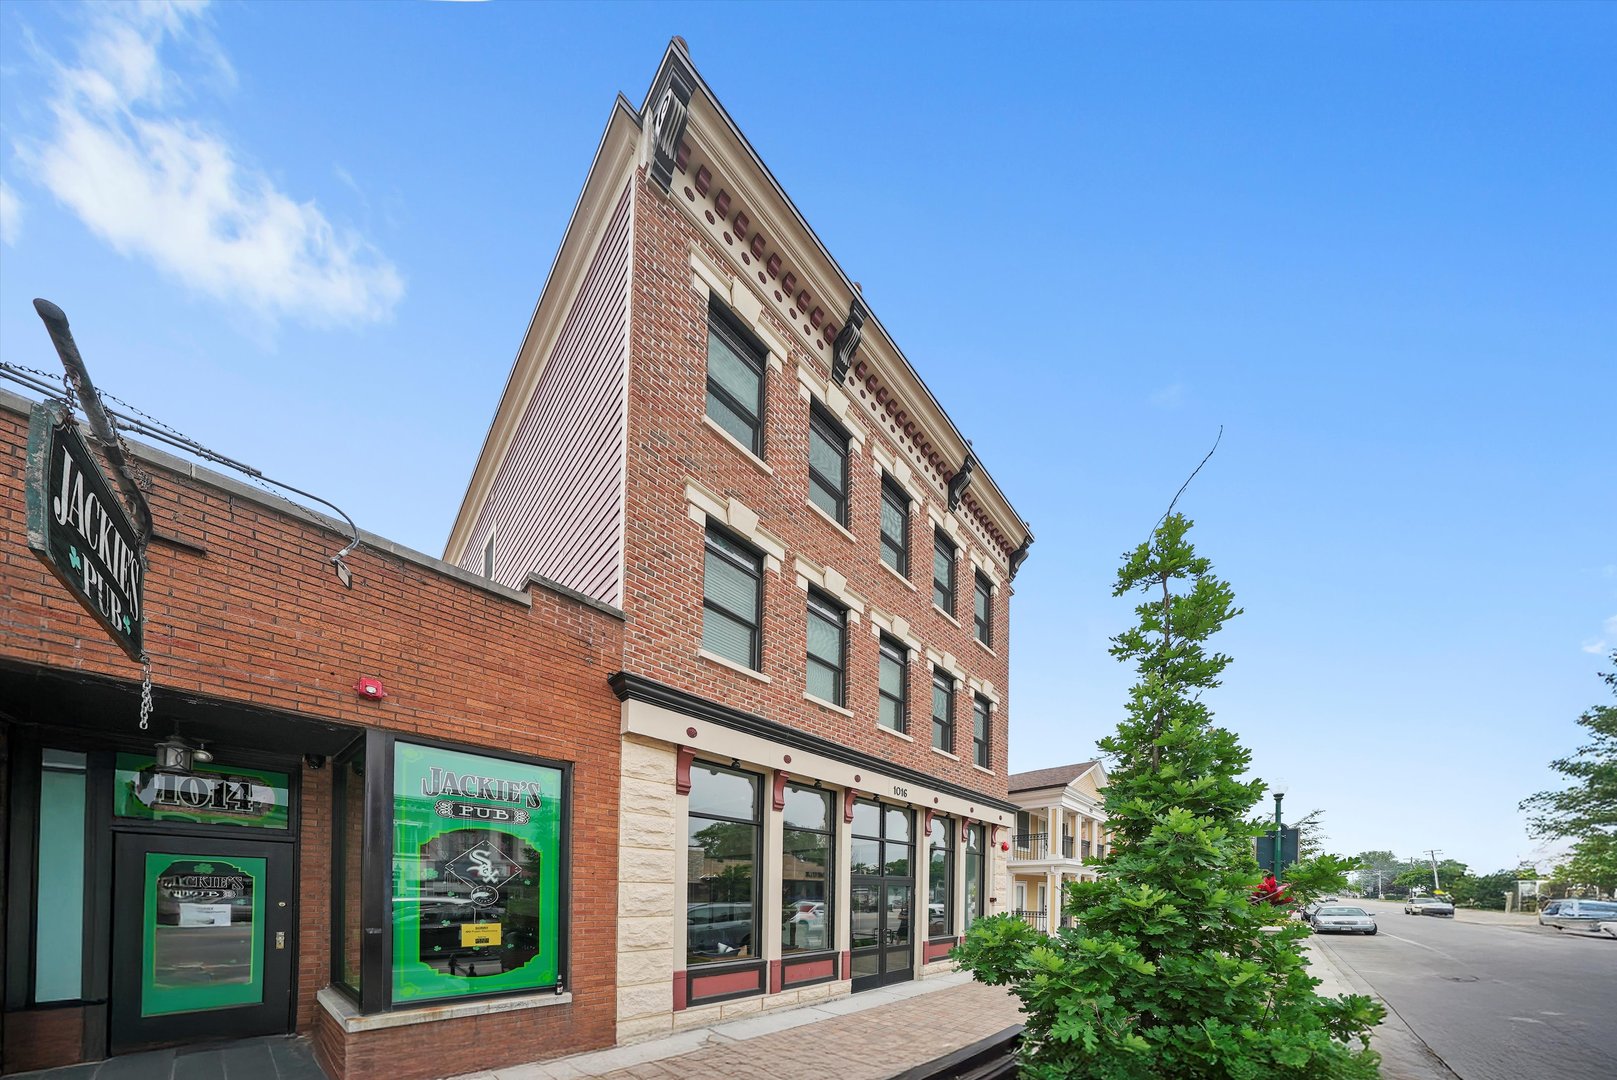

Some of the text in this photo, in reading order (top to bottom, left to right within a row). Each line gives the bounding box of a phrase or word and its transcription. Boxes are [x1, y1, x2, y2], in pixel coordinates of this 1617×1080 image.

[53, 445, 139, 622] JACKIE'S
[81, 553, 123, 631] PUB
[156, 772, 253, 812] 1014
[421, 766, 541, 809] JACKIE'S
[893, 785, 908, 798] 1016
[458, 804, 509, 820] PUB
[163, 876, 244, 890] CKIE'S
